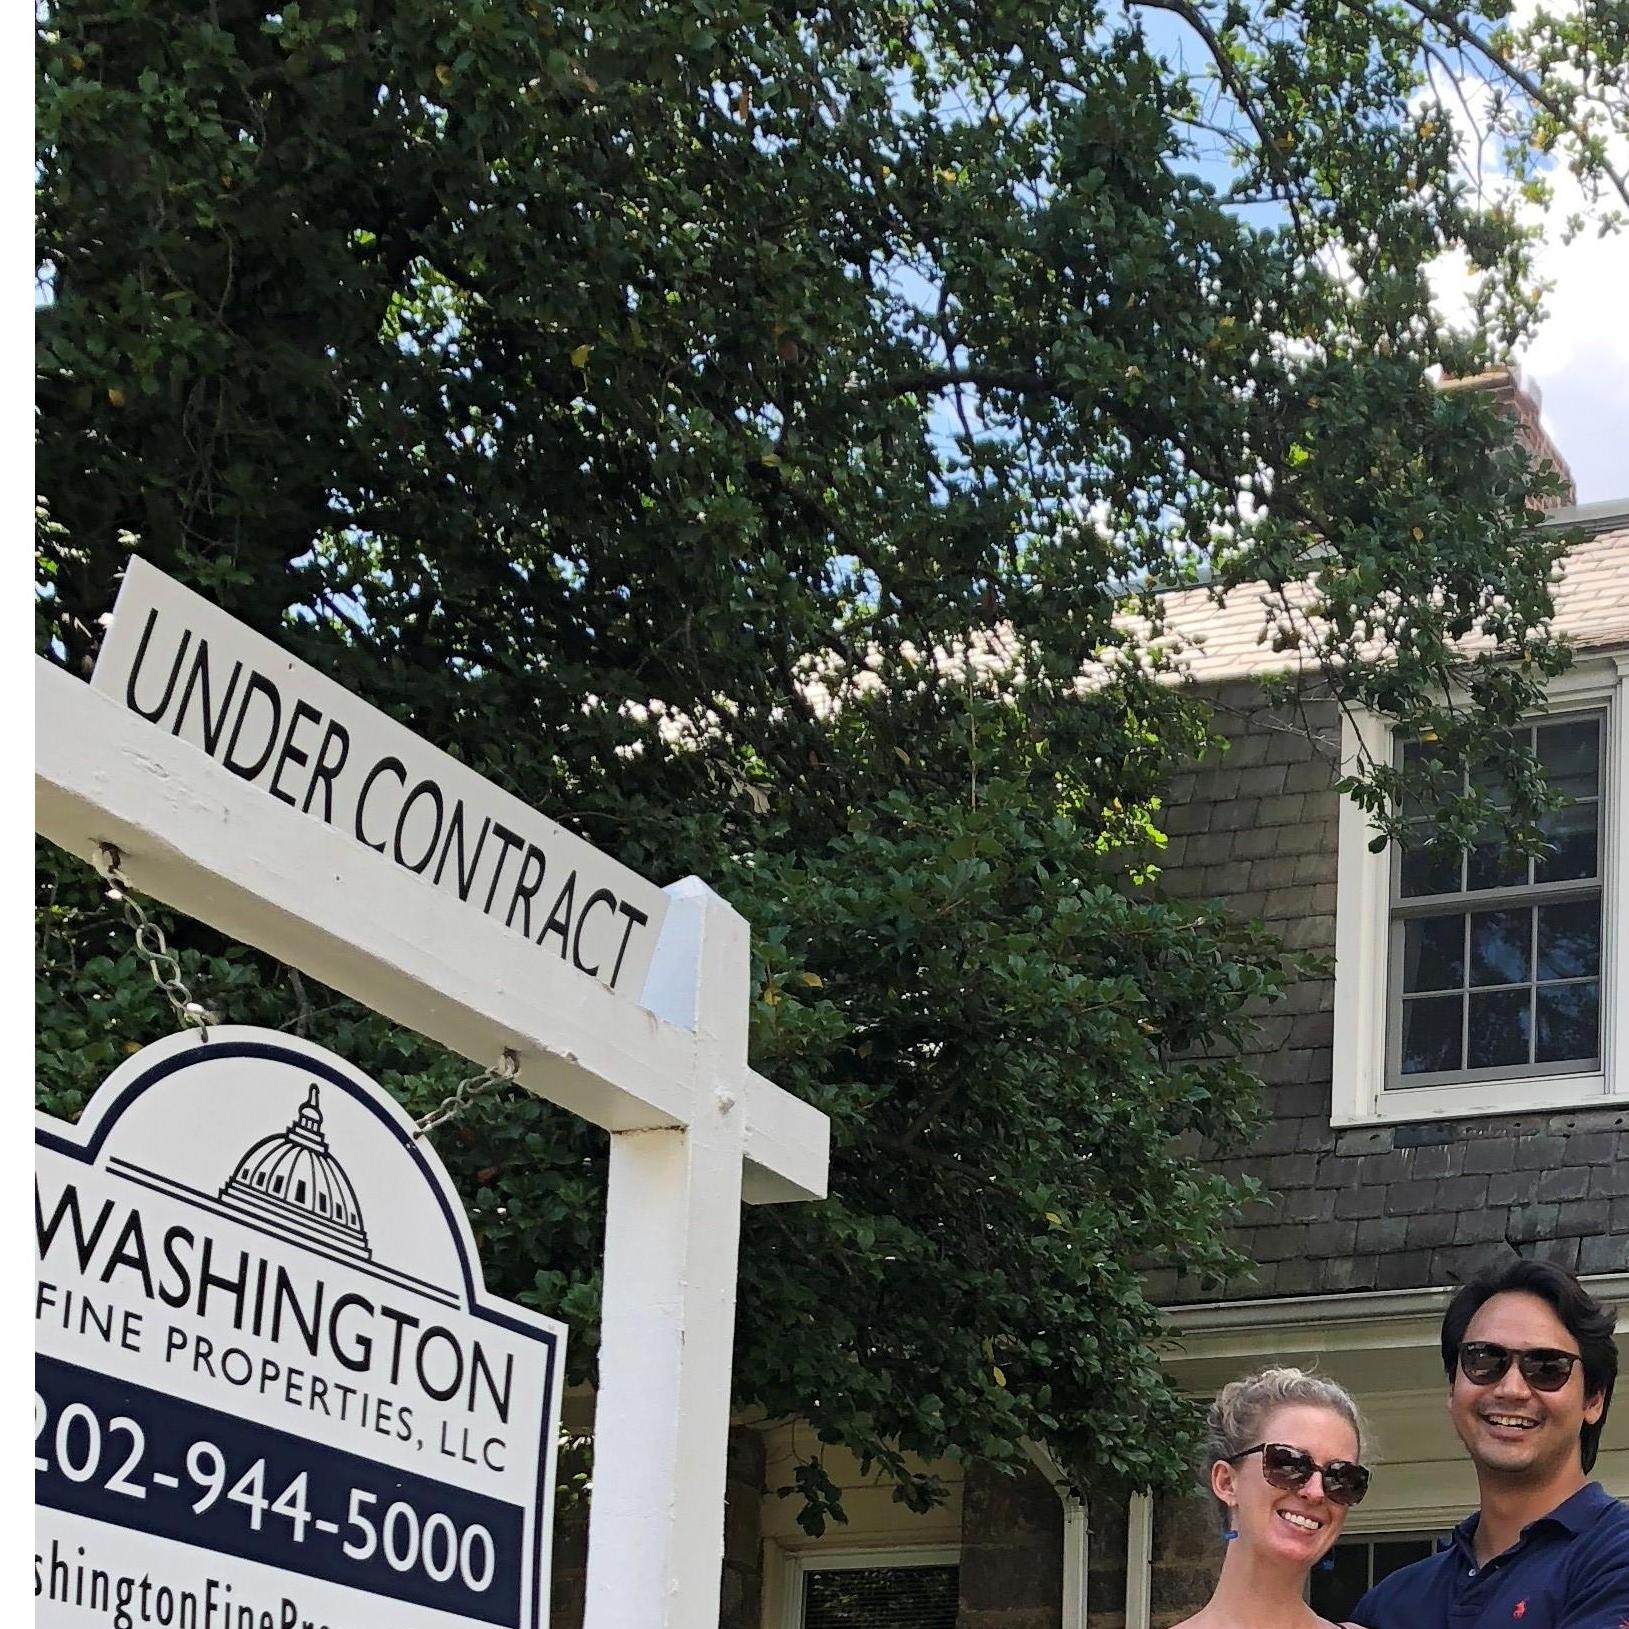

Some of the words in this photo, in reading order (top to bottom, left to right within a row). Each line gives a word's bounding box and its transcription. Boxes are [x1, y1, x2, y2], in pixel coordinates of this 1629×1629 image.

[126, 607, 350, 825] UNDER
[355, 756, 649, 989] CONTRACT
[35, 1171, 514, 1424] WASHINGTON
[35, 1281, 143, 1353] FINE
[165, 1324, 423, 1452] PROPERTIES,
[440, 1420, 507, 1473] LLC
